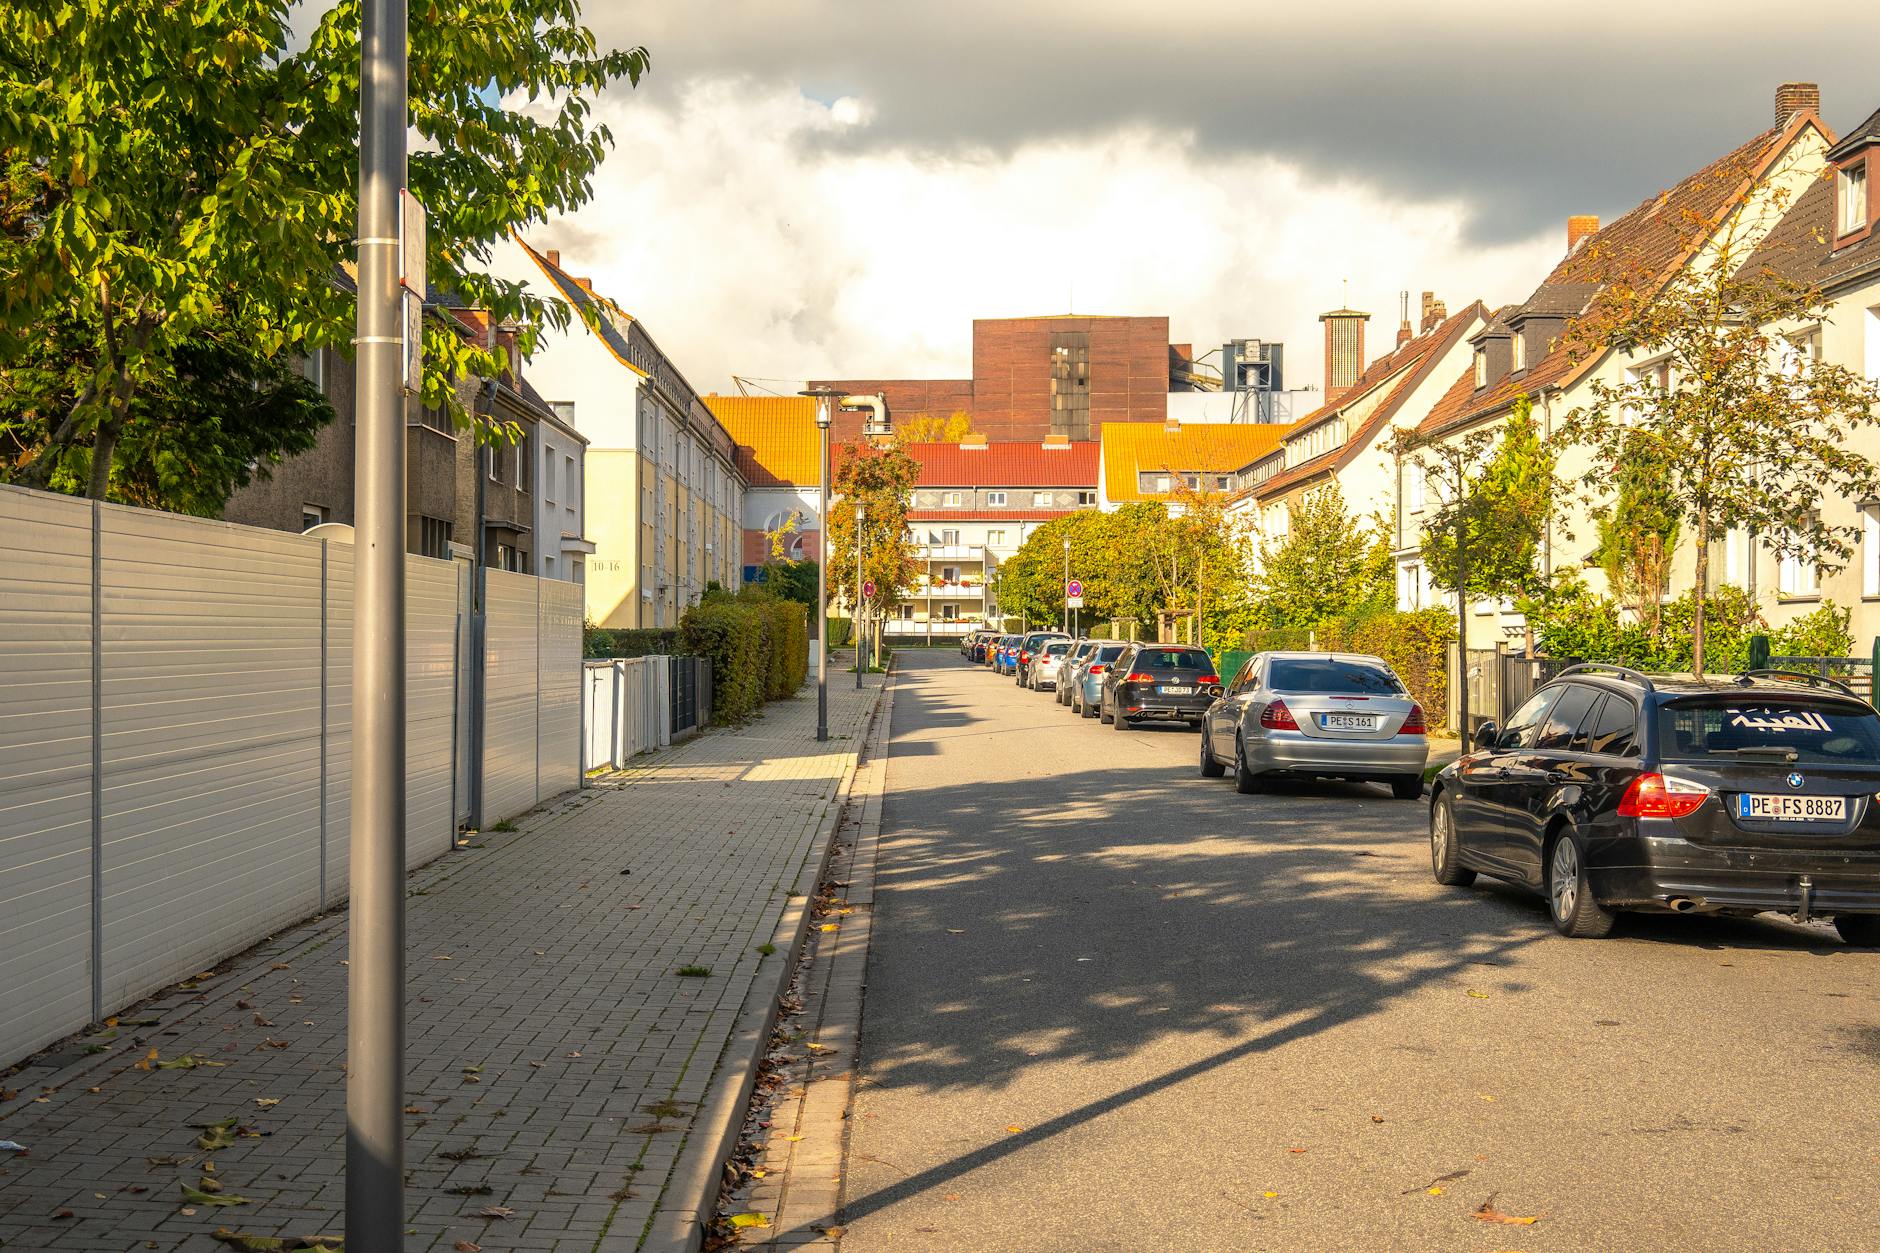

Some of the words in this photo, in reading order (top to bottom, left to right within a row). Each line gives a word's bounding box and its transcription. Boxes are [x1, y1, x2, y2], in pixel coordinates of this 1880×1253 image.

[1331, 717, 1342, 726] PE
[1348, 717, 1354, 726] S
[1356, 717, 1372, 727] 161
[1751, 798, 1770, 814] PE
[1783, 799, 1801, 814] FS
[1806, 799, 1842, 816] 8887
